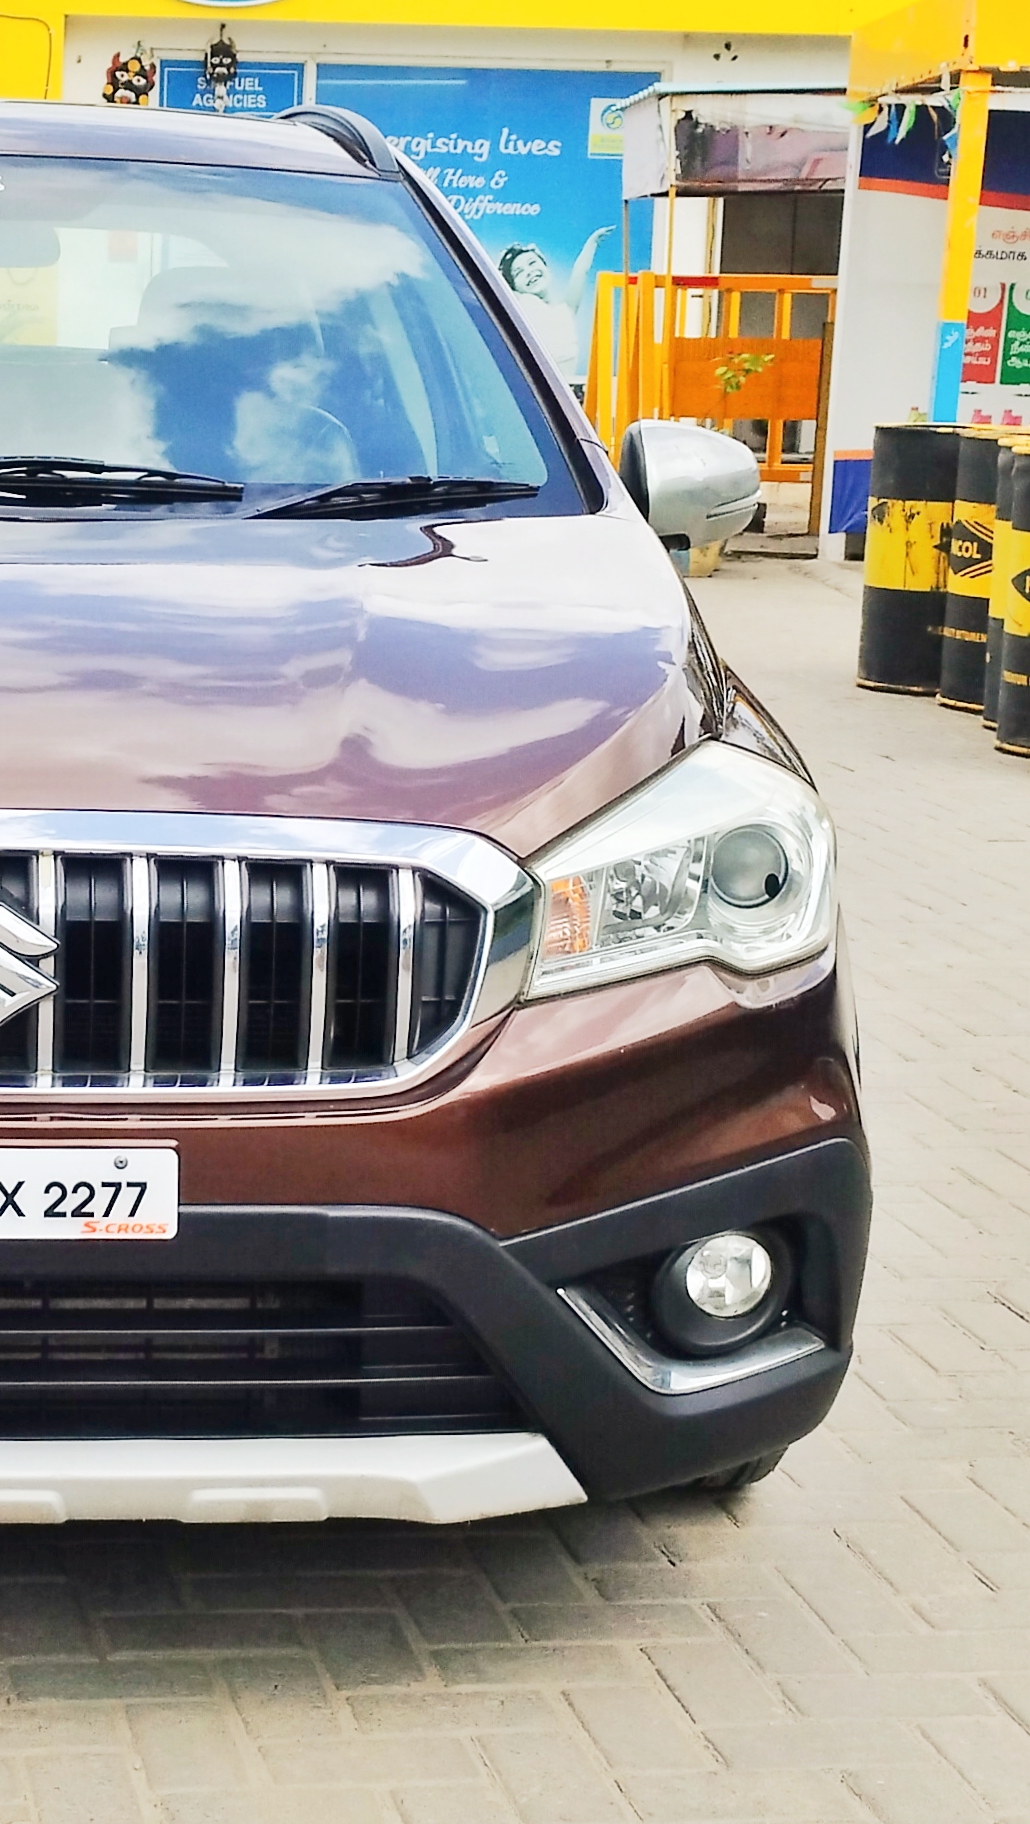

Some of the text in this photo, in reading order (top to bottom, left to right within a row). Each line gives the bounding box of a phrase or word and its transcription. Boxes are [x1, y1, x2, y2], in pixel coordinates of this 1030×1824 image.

[192, 93, 267, 108] AGNCIES
[385, 132, 490, 162] ergising
[499, 127, 562, 156] lives
[443, 168, 485, 188] Here
[490, 170, 508, 189] &
[447, 195, 541, 219] Difference
[974, 245, 1027, 261] க்கமாக
[43, 1182, 147, 1217] 2277
